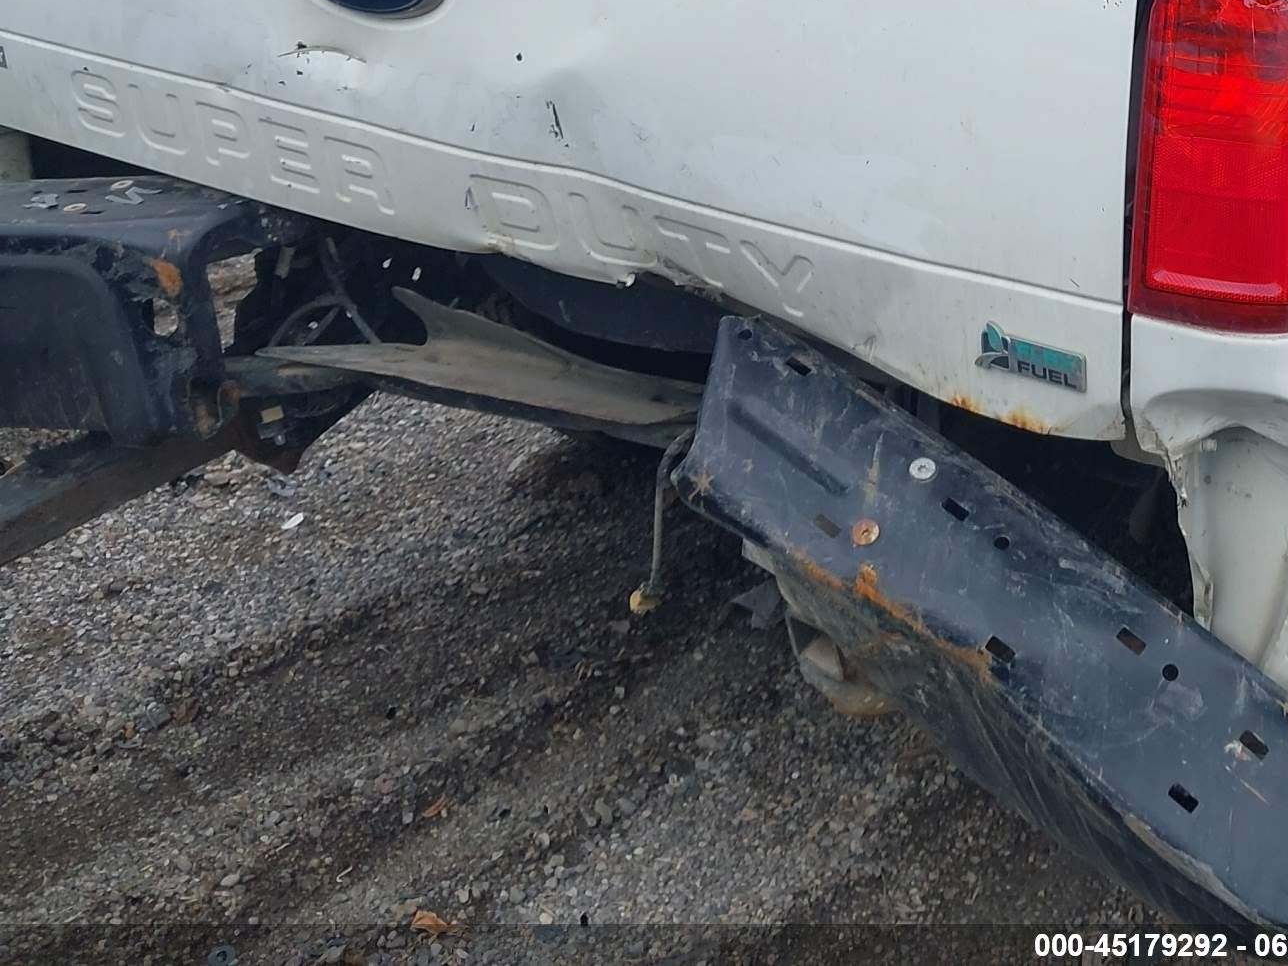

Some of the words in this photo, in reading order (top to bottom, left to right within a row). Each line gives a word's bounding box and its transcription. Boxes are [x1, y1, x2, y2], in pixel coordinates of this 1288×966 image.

[70, 70, 396, 215] SUPER
[469, 173, 815, 318] DUTY
[1016, 359, 1078, 390] FUEL
